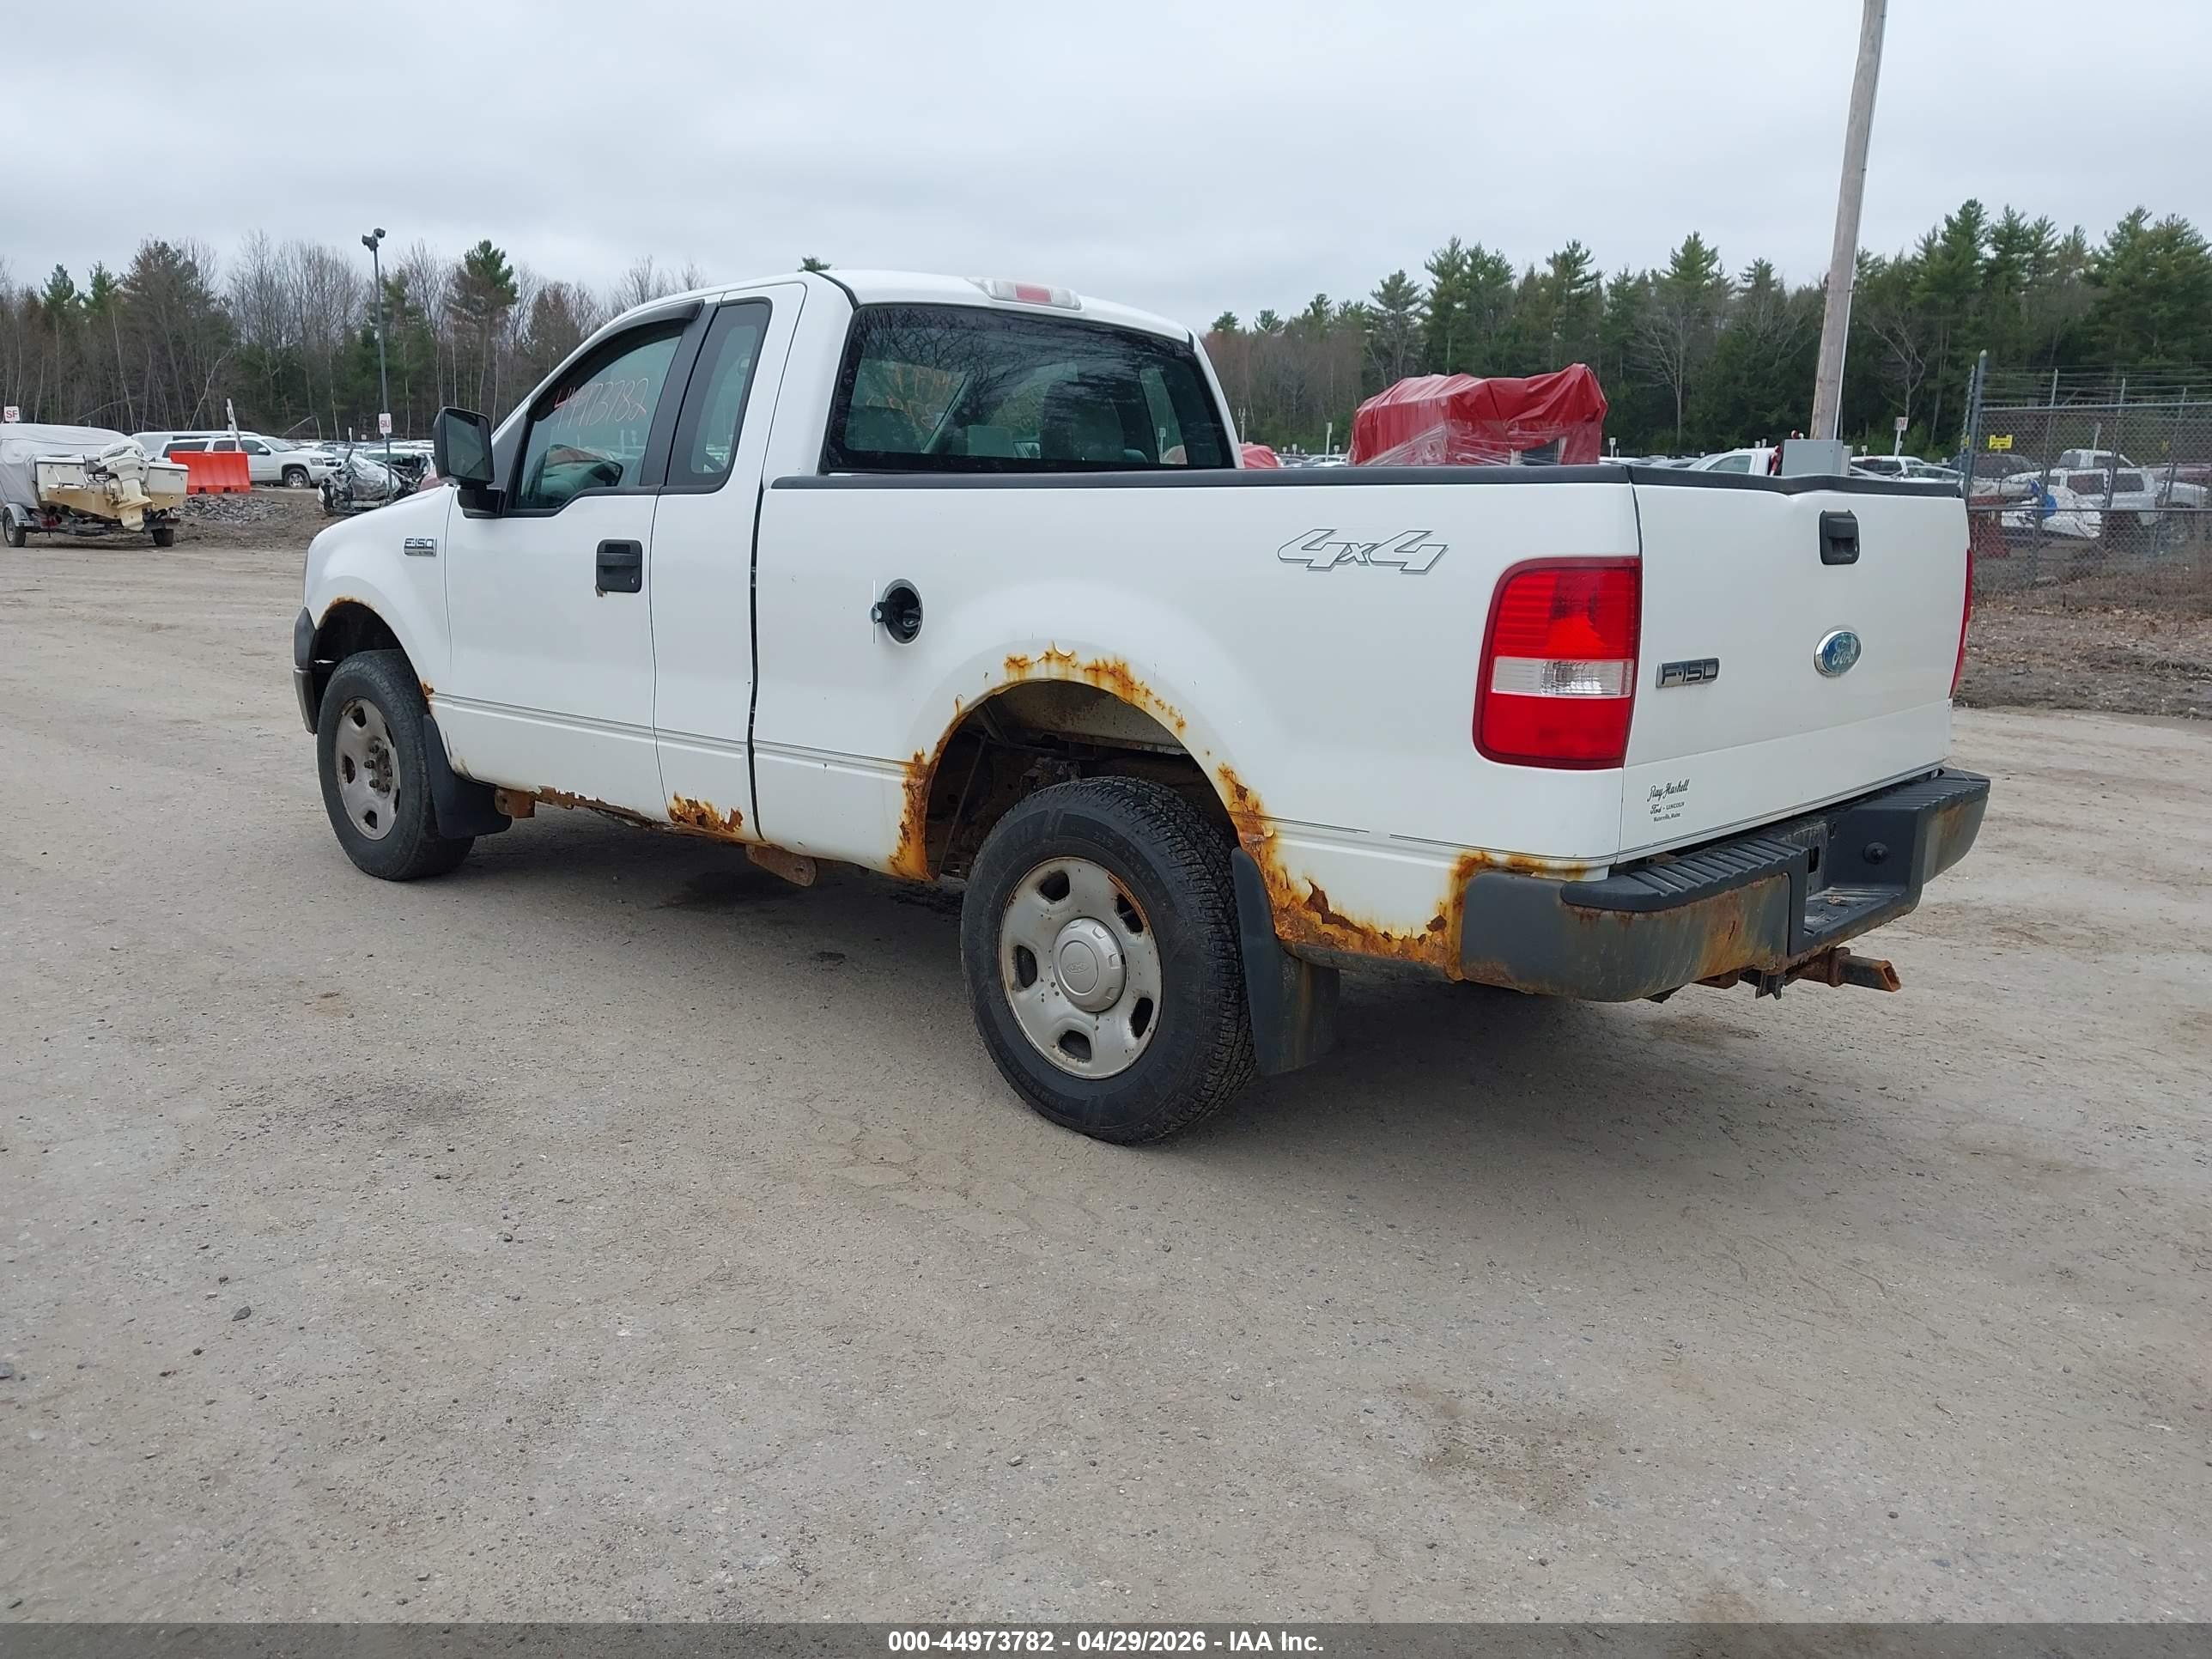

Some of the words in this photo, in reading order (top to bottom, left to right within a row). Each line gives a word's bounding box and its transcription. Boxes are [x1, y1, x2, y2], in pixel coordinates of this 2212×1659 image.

[1277, 528, 1449, 574] 4x4
[1647, 785, 1663, 802] Ray
[1662, 778, 1690, 799] Haskell
